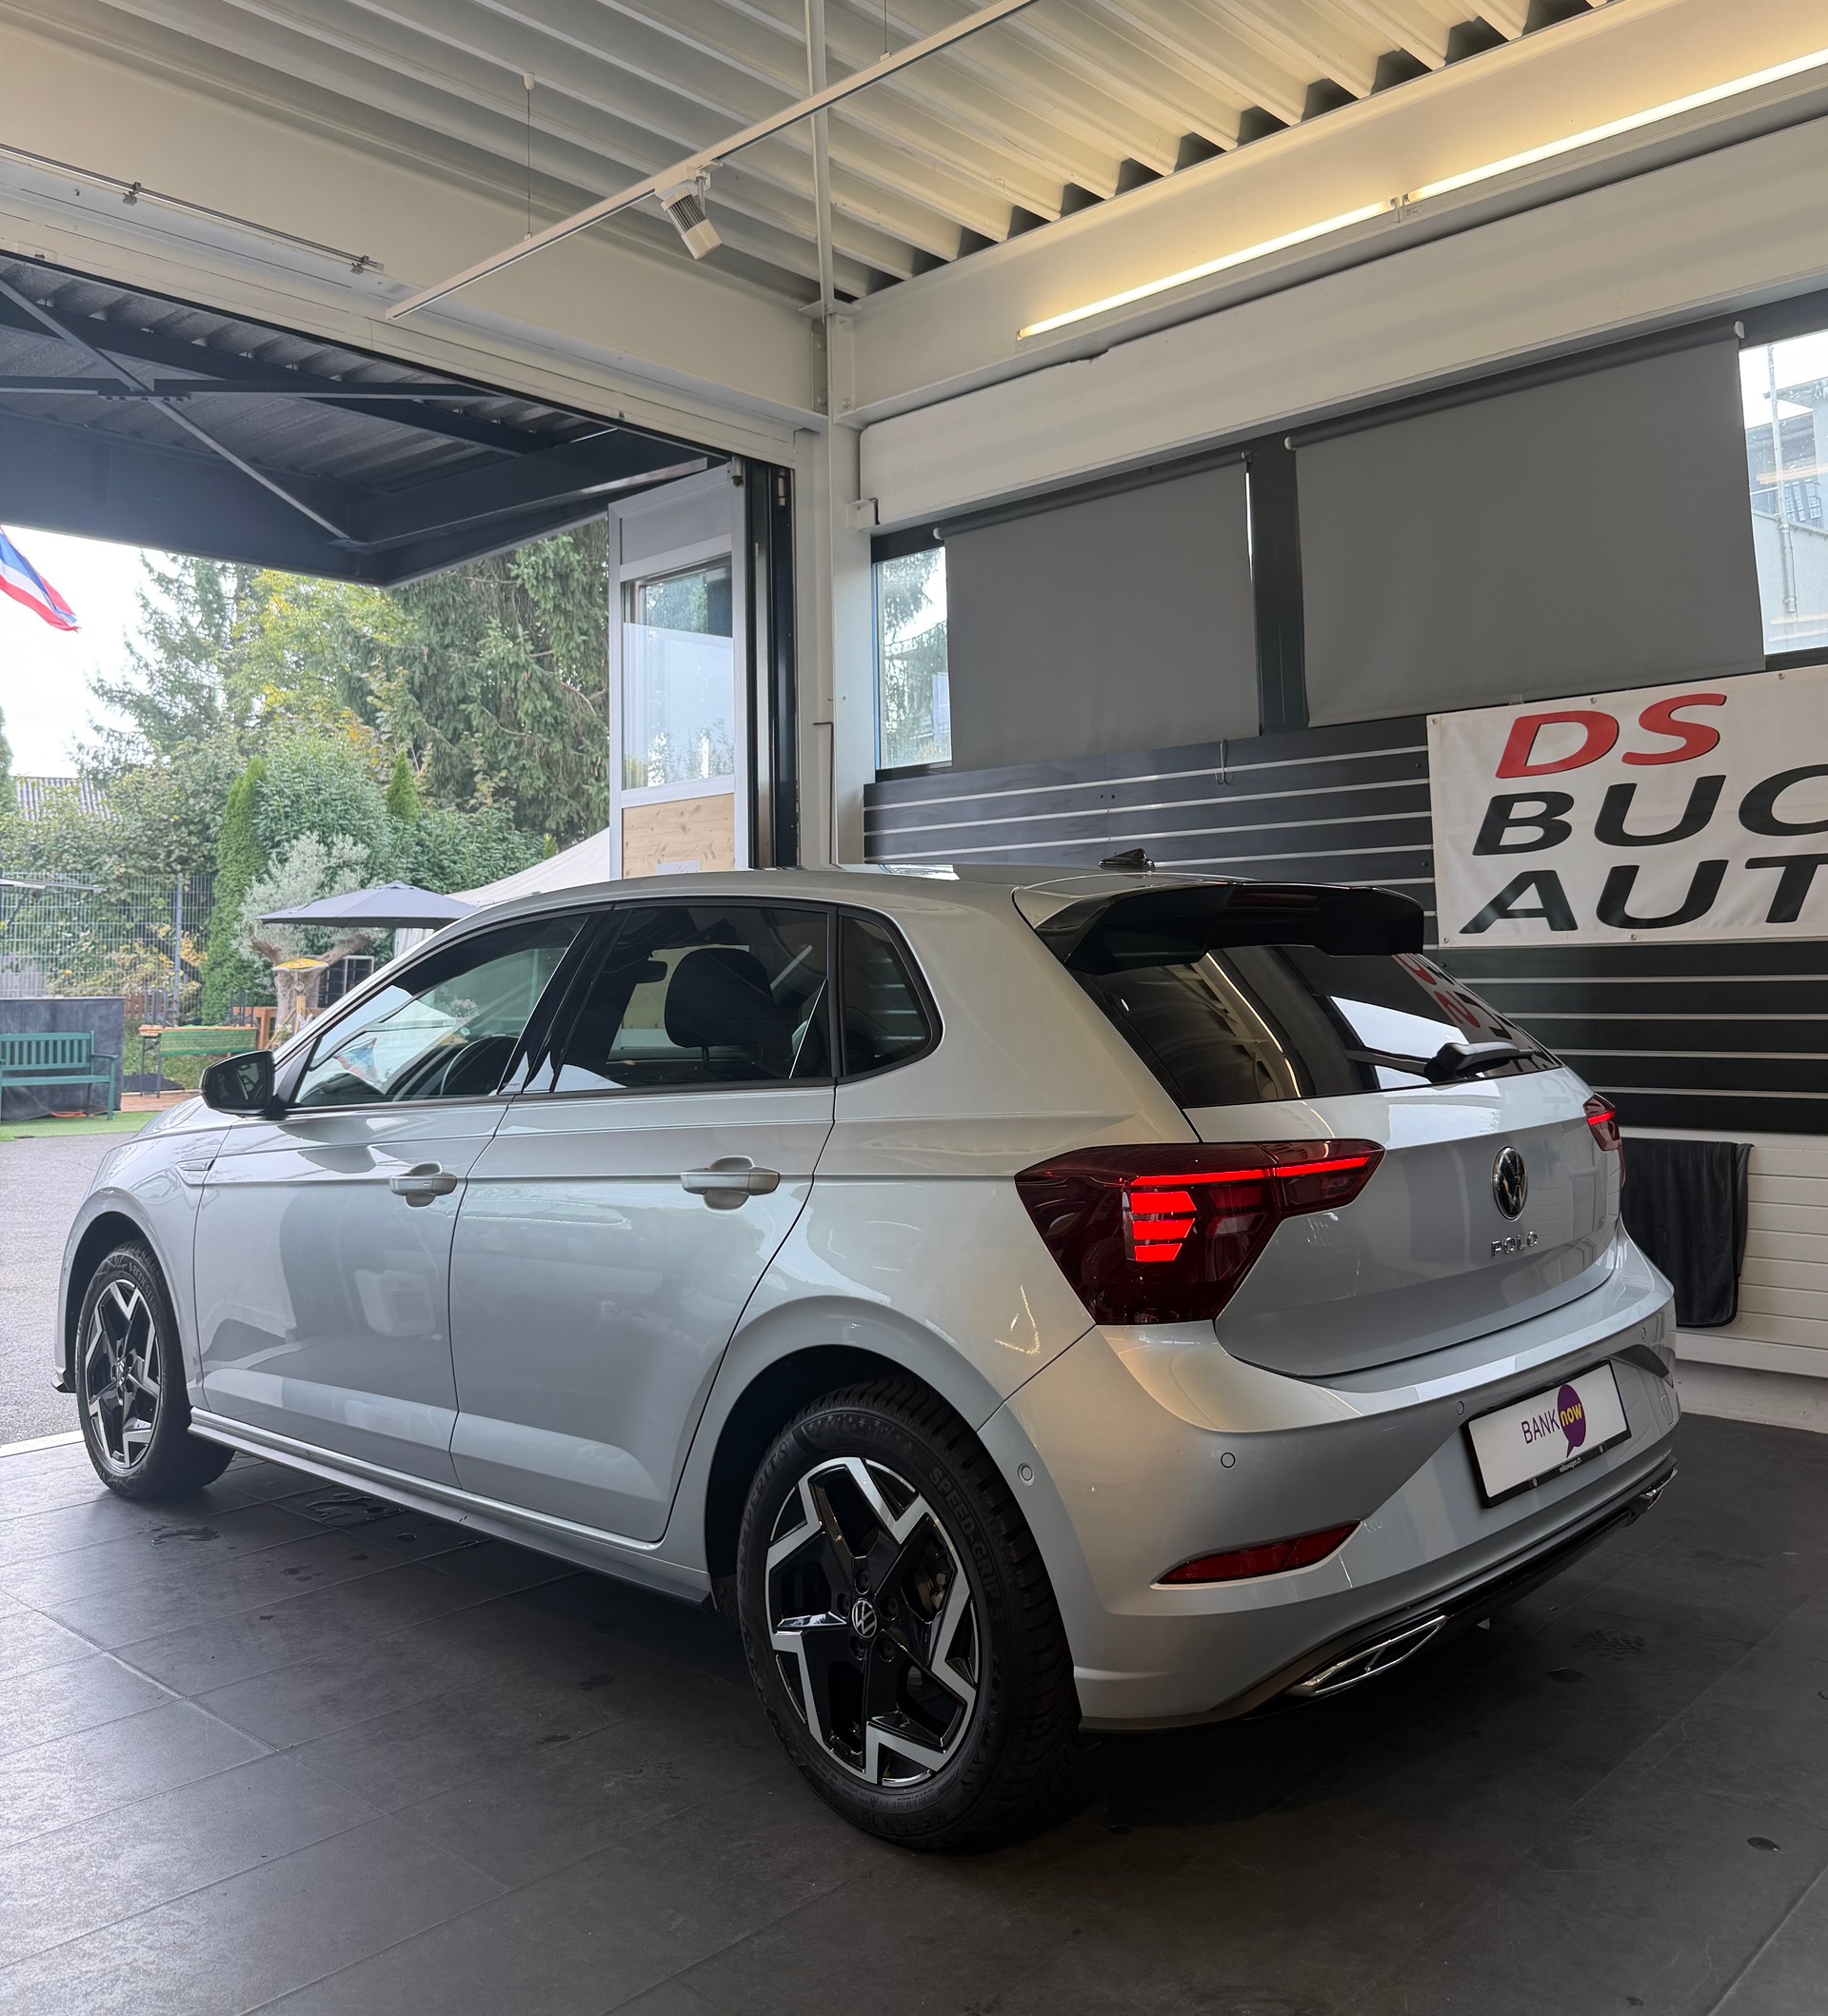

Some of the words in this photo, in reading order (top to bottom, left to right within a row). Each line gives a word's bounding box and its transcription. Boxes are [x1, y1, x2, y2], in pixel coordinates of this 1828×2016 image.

[1495, 693, 1727, 779] DS
[1459, 854, 1828, 934] AUT
[1491, 1231, 1539, 1258] POLO
[1520, 1409, 1560, 1444] BANK
[1560, 1403, 1582, 1427] now
[929, 1466, 1001, 1598] SPEED-GRIP
